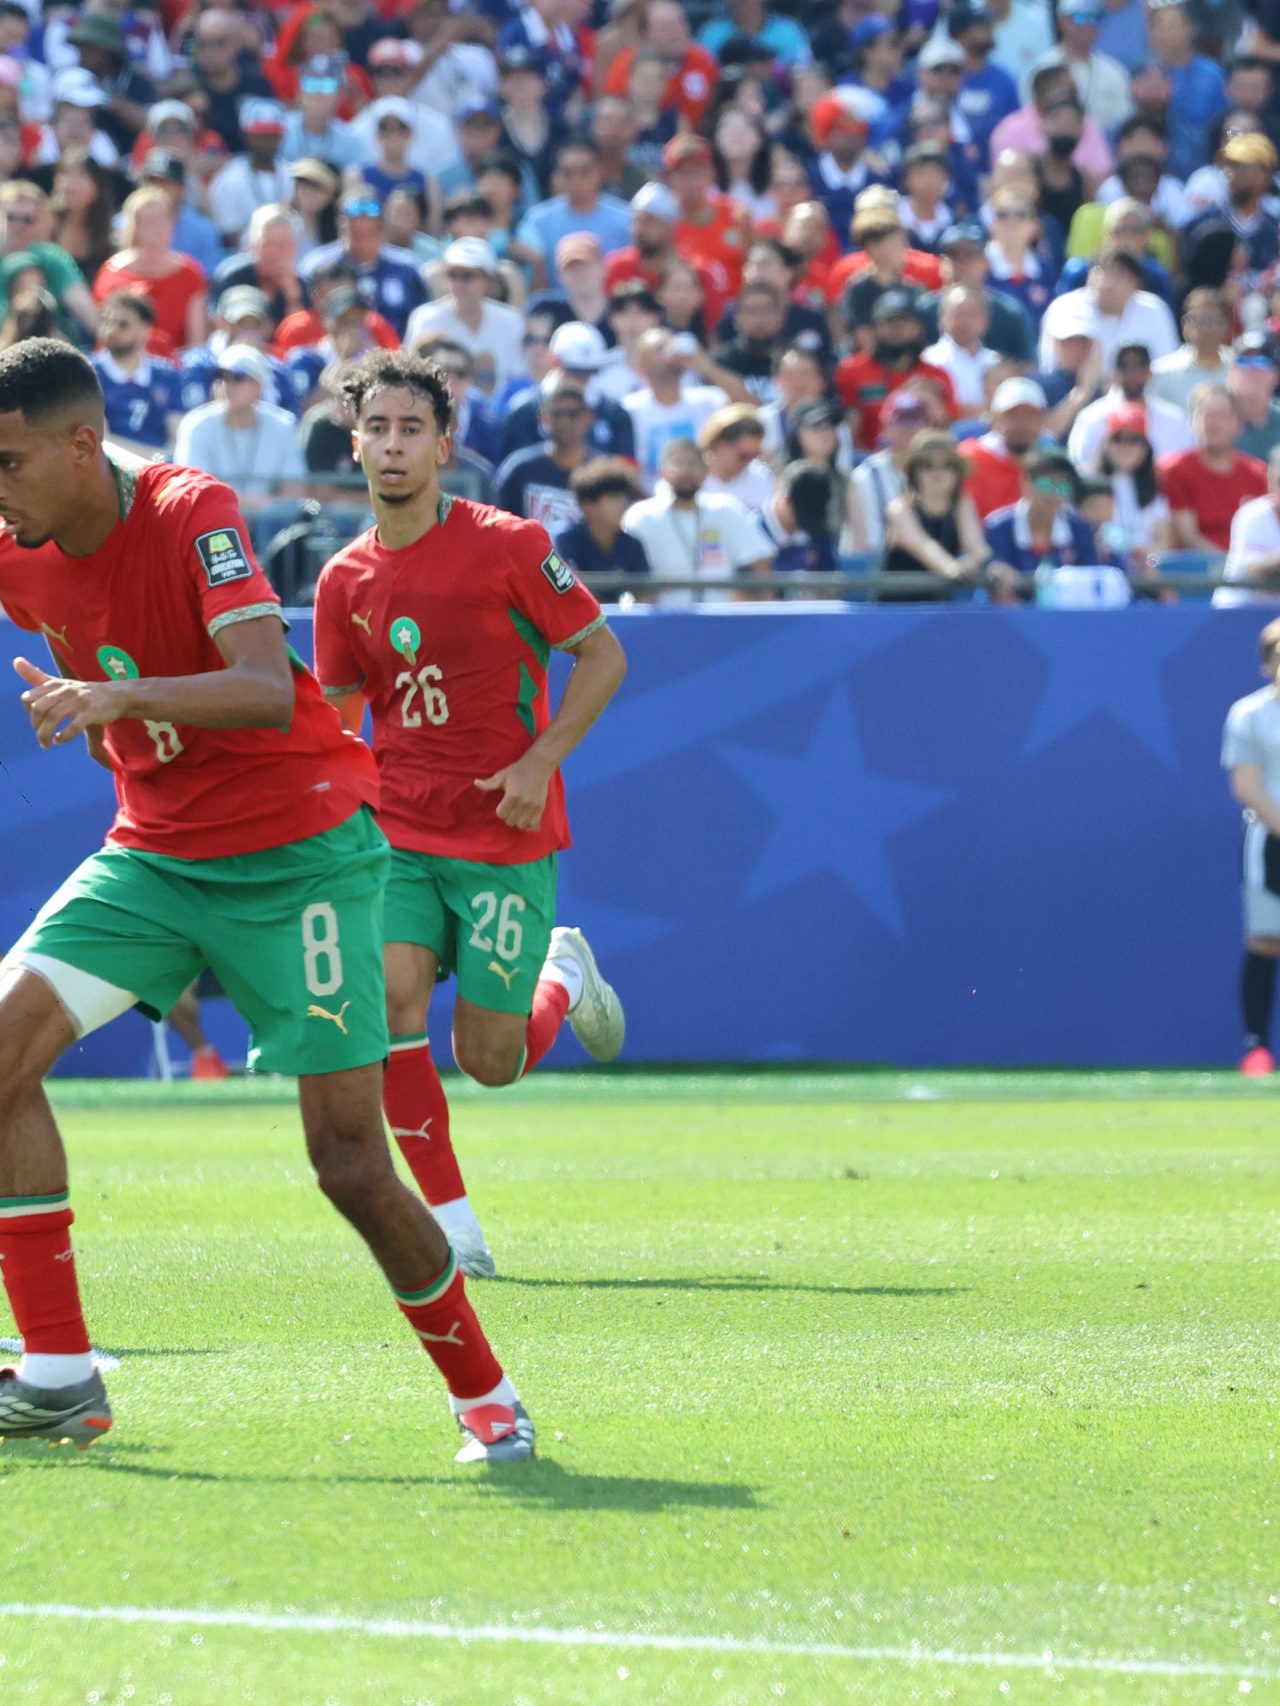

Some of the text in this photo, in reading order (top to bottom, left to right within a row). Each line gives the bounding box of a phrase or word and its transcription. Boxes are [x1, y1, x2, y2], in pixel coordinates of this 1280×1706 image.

[395, 664, 449, 728] 26
[301, 902, 344, 996] 8
[468, 891, 525, 960] 26
